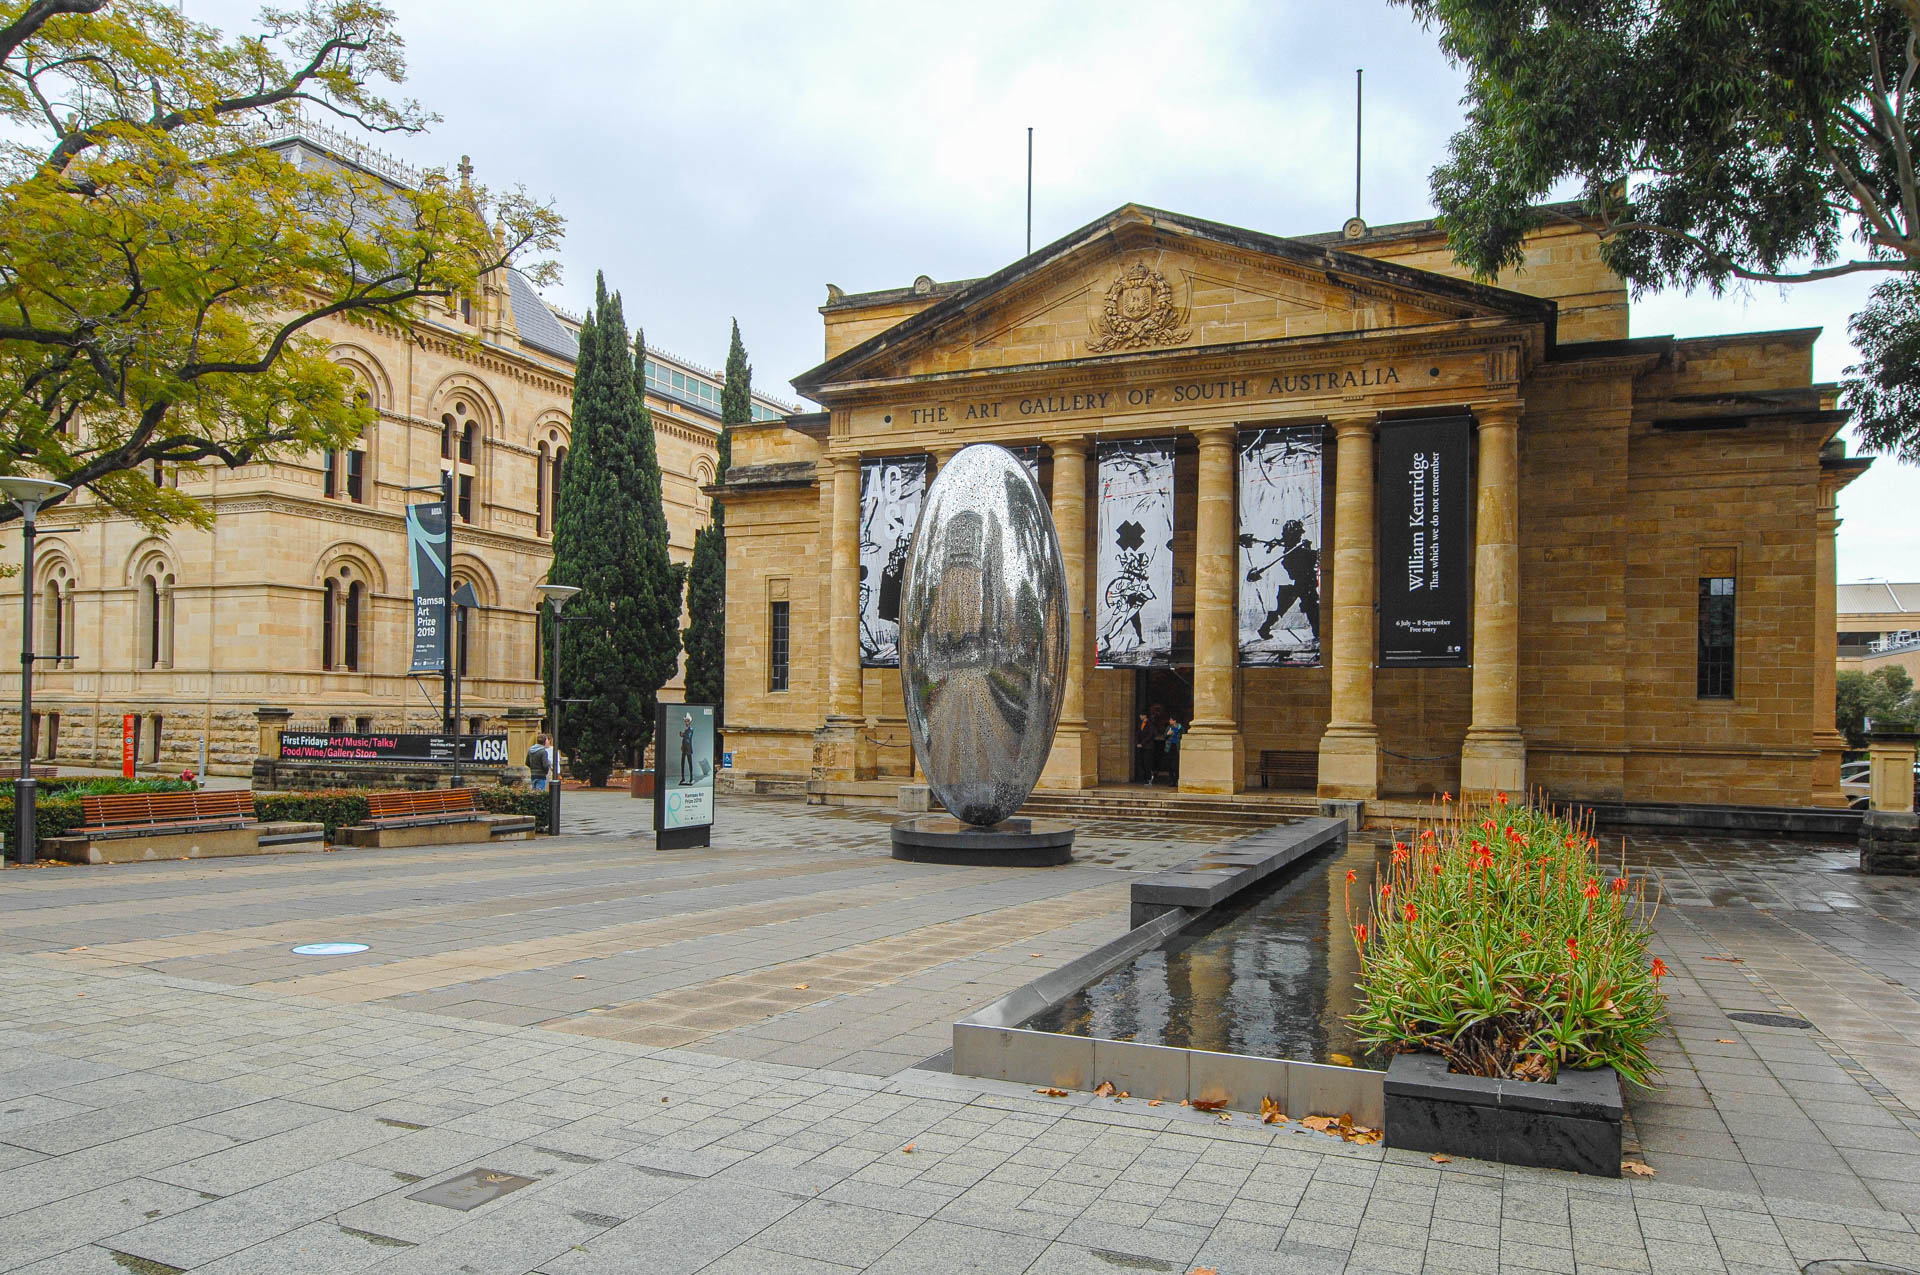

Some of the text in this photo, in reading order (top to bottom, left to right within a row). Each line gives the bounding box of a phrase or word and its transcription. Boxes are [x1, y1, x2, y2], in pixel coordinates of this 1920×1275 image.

[911, 367, 1400, 424] THE ART GALLERY OF SOUTH AUSTRALIA
[1430, 451, 1440, 496] remember
[865, 465, 902, 502] AG
[1408, 452, 1429, 592] William Kentridge
[1430, 514, 1439, 527] do
[1432, 528, 1439, 541] we
[1430, 542, 1439, 569] which
[1430, 570, 1439, 590] That
[416, 596, 446, 606] Ramsay
[417, 606, 429, 616] Art
[417, 616, 436, 626] Prize
[1400, 619, 1411, 627] July
[1422, 619, 1451, 627] September
[417, 627, 435, 637] 2019
[282, 735, 398, 749] First Fridays Art/Music/Talks/
[355, 748, 377, 758] Store
[474, 739, 509, 761] AGSA
